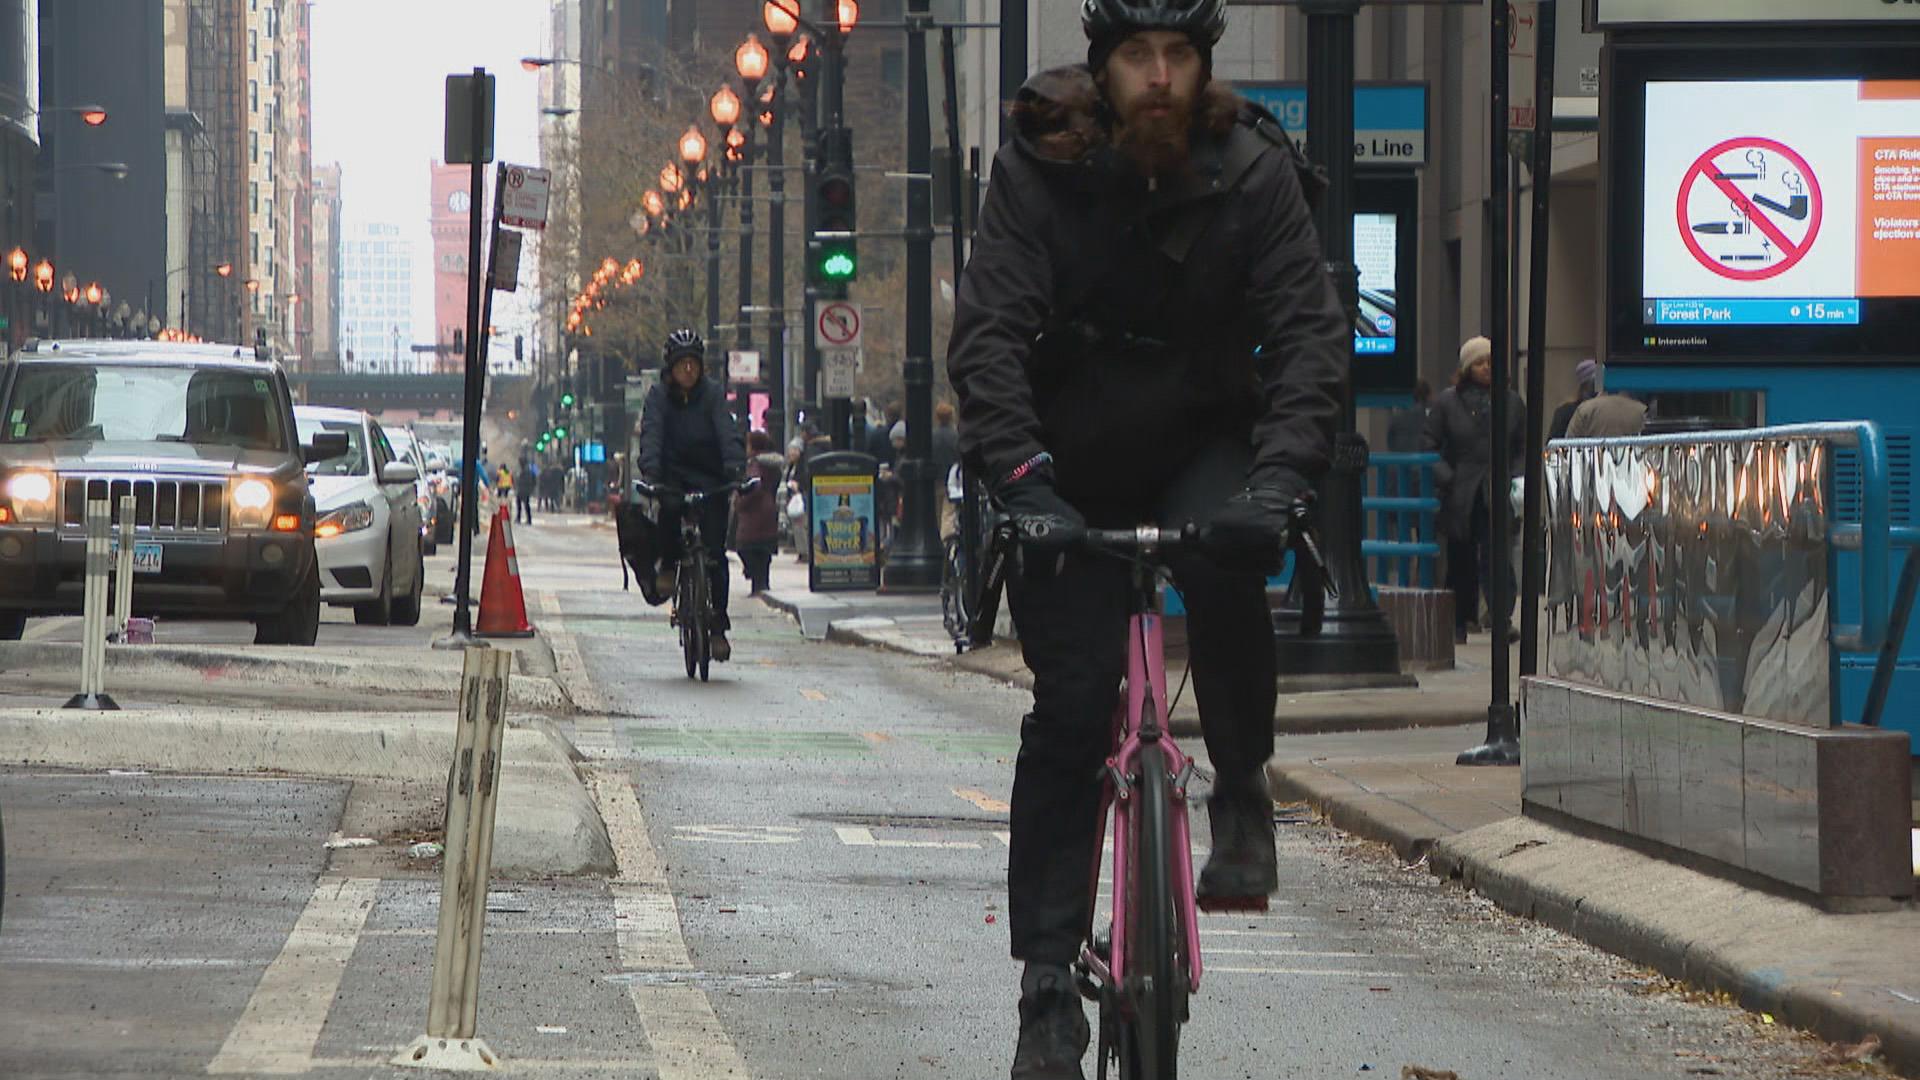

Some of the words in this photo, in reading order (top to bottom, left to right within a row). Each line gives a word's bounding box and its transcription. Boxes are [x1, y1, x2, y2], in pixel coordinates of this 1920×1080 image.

[1372, 139, 1413, 156] Line
[1874, 149, 1897, 160] CTA
[1873, 183, 1890, 192] CTA
[1886, 192, 1902, 200] CTA
[1874, 217, 1919, 229] Violators
[1873, 229, 1914, 241] ejection
[1661, 307, 1700, 321] Forest
[1703, 307, 1731, 320] Park
[1806, 303, 1825, 319] 15
[1827, 308, 1844, 319] min
[1657, 336, 1708, 345] Intersection
